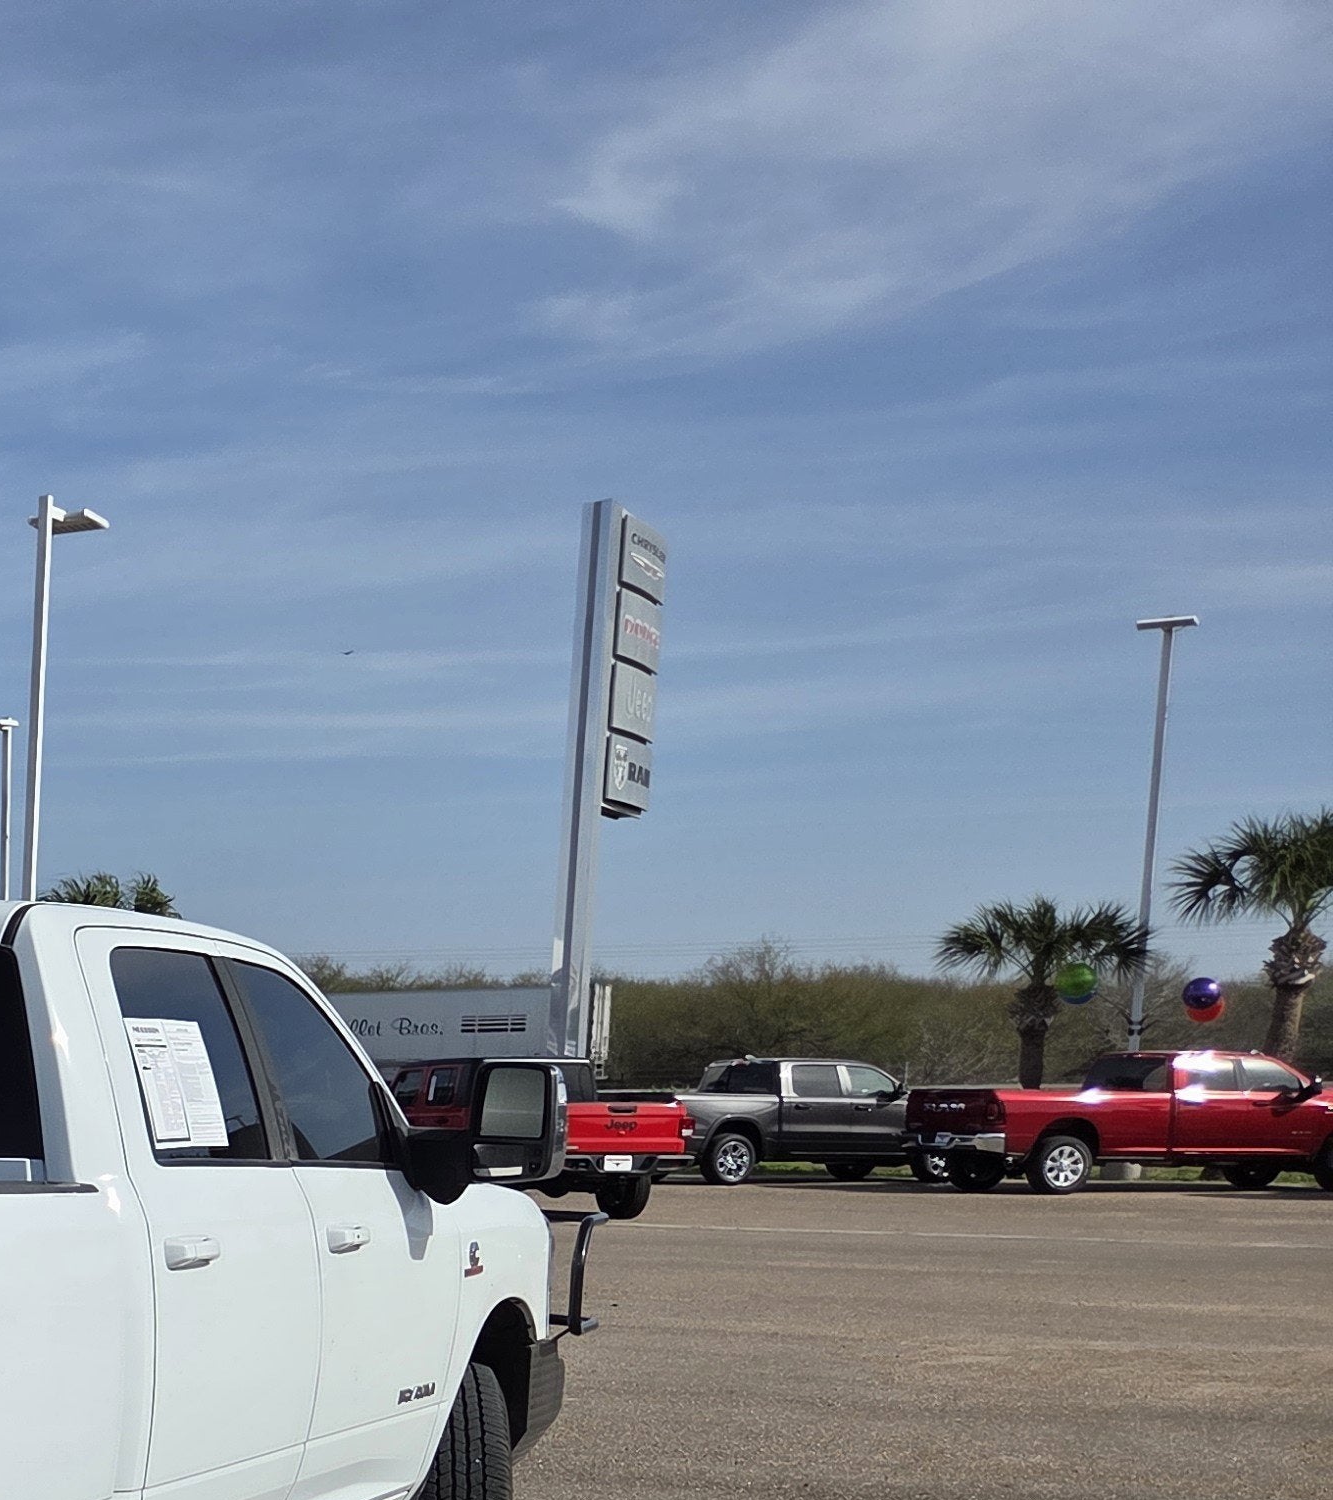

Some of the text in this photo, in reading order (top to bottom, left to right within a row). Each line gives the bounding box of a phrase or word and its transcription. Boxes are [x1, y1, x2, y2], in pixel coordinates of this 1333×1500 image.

[391, 1017, 444, 1036] Bros.
[604, 1119, 638, 1131] Jeep
[397, 1381, 436, 1406] RAM
